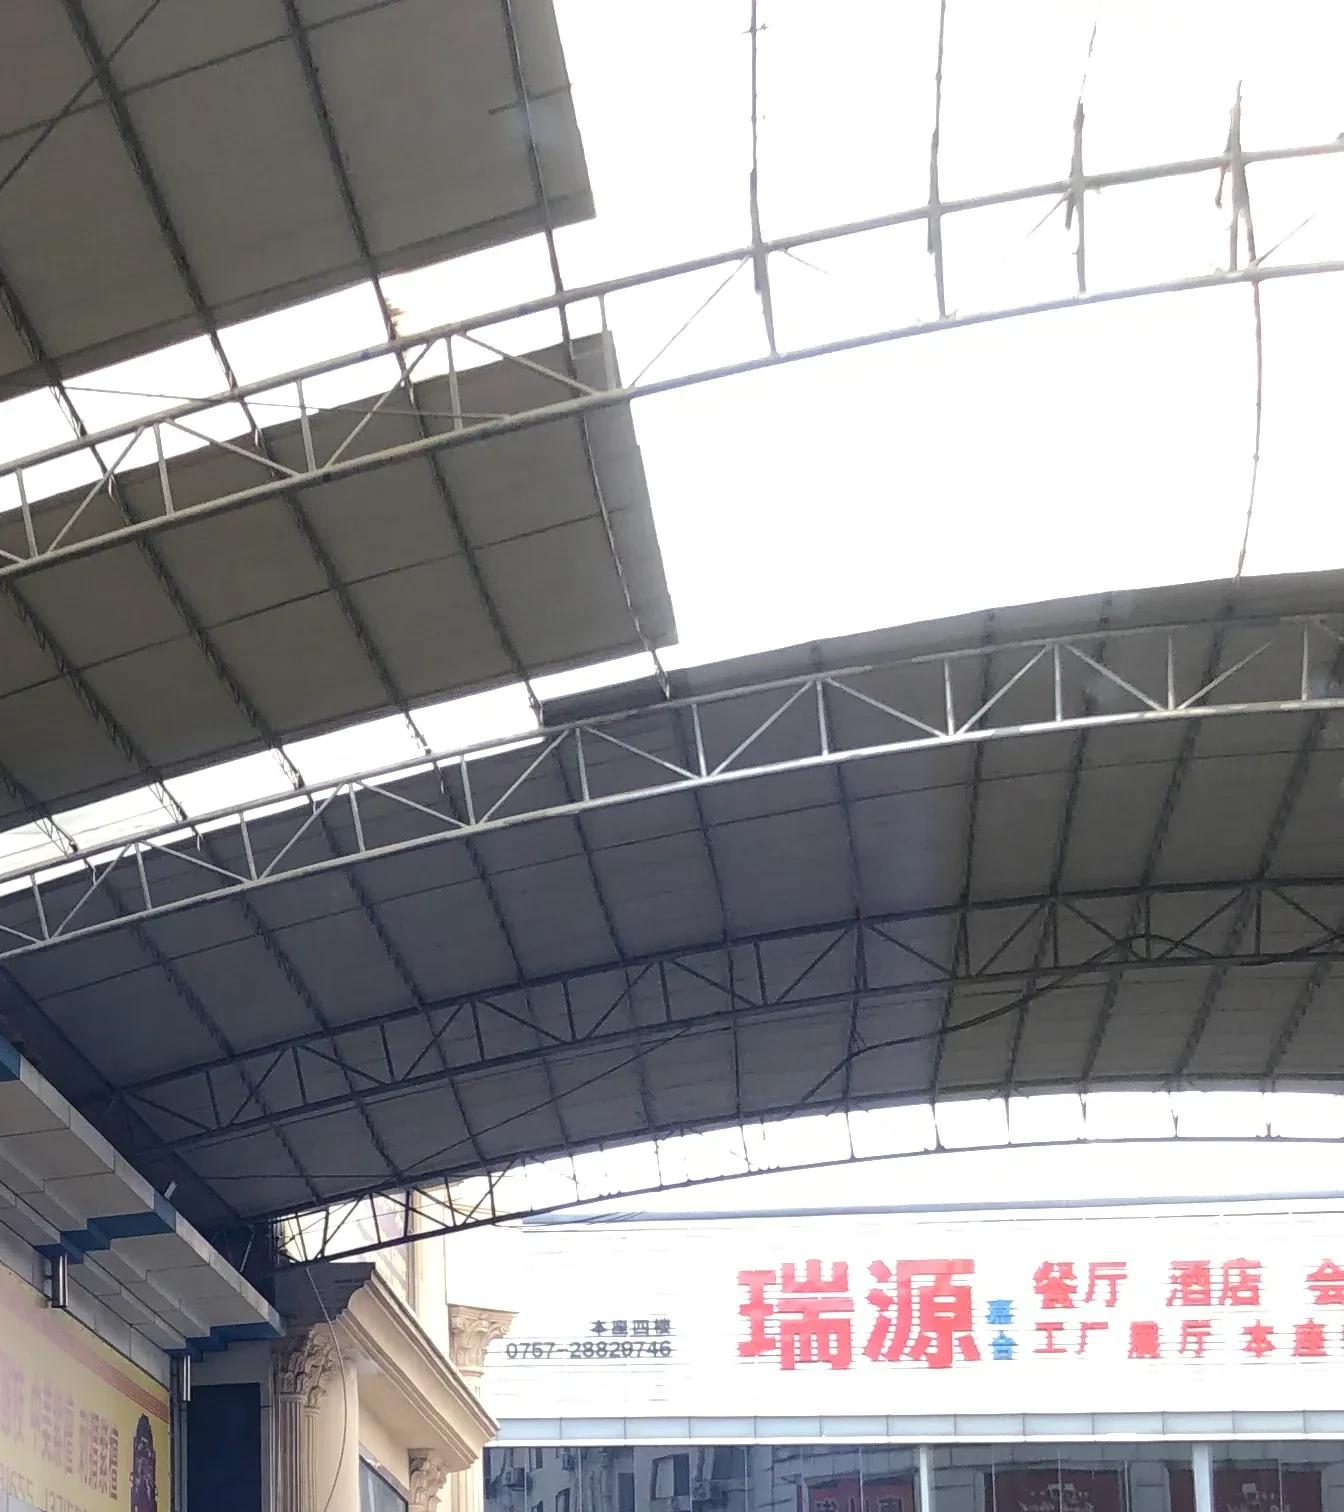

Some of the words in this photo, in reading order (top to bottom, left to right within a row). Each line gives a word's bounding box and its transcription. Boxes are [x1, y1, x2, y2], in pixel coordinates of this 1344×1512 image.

[591, 1320, 671, 1336] 本座四楼
[738, 1259, 981, 1370] 瑞源
[1032, 1260, 1127, 1309] 餐厅
[1166, 1258, 1264, 1306] 酒店
